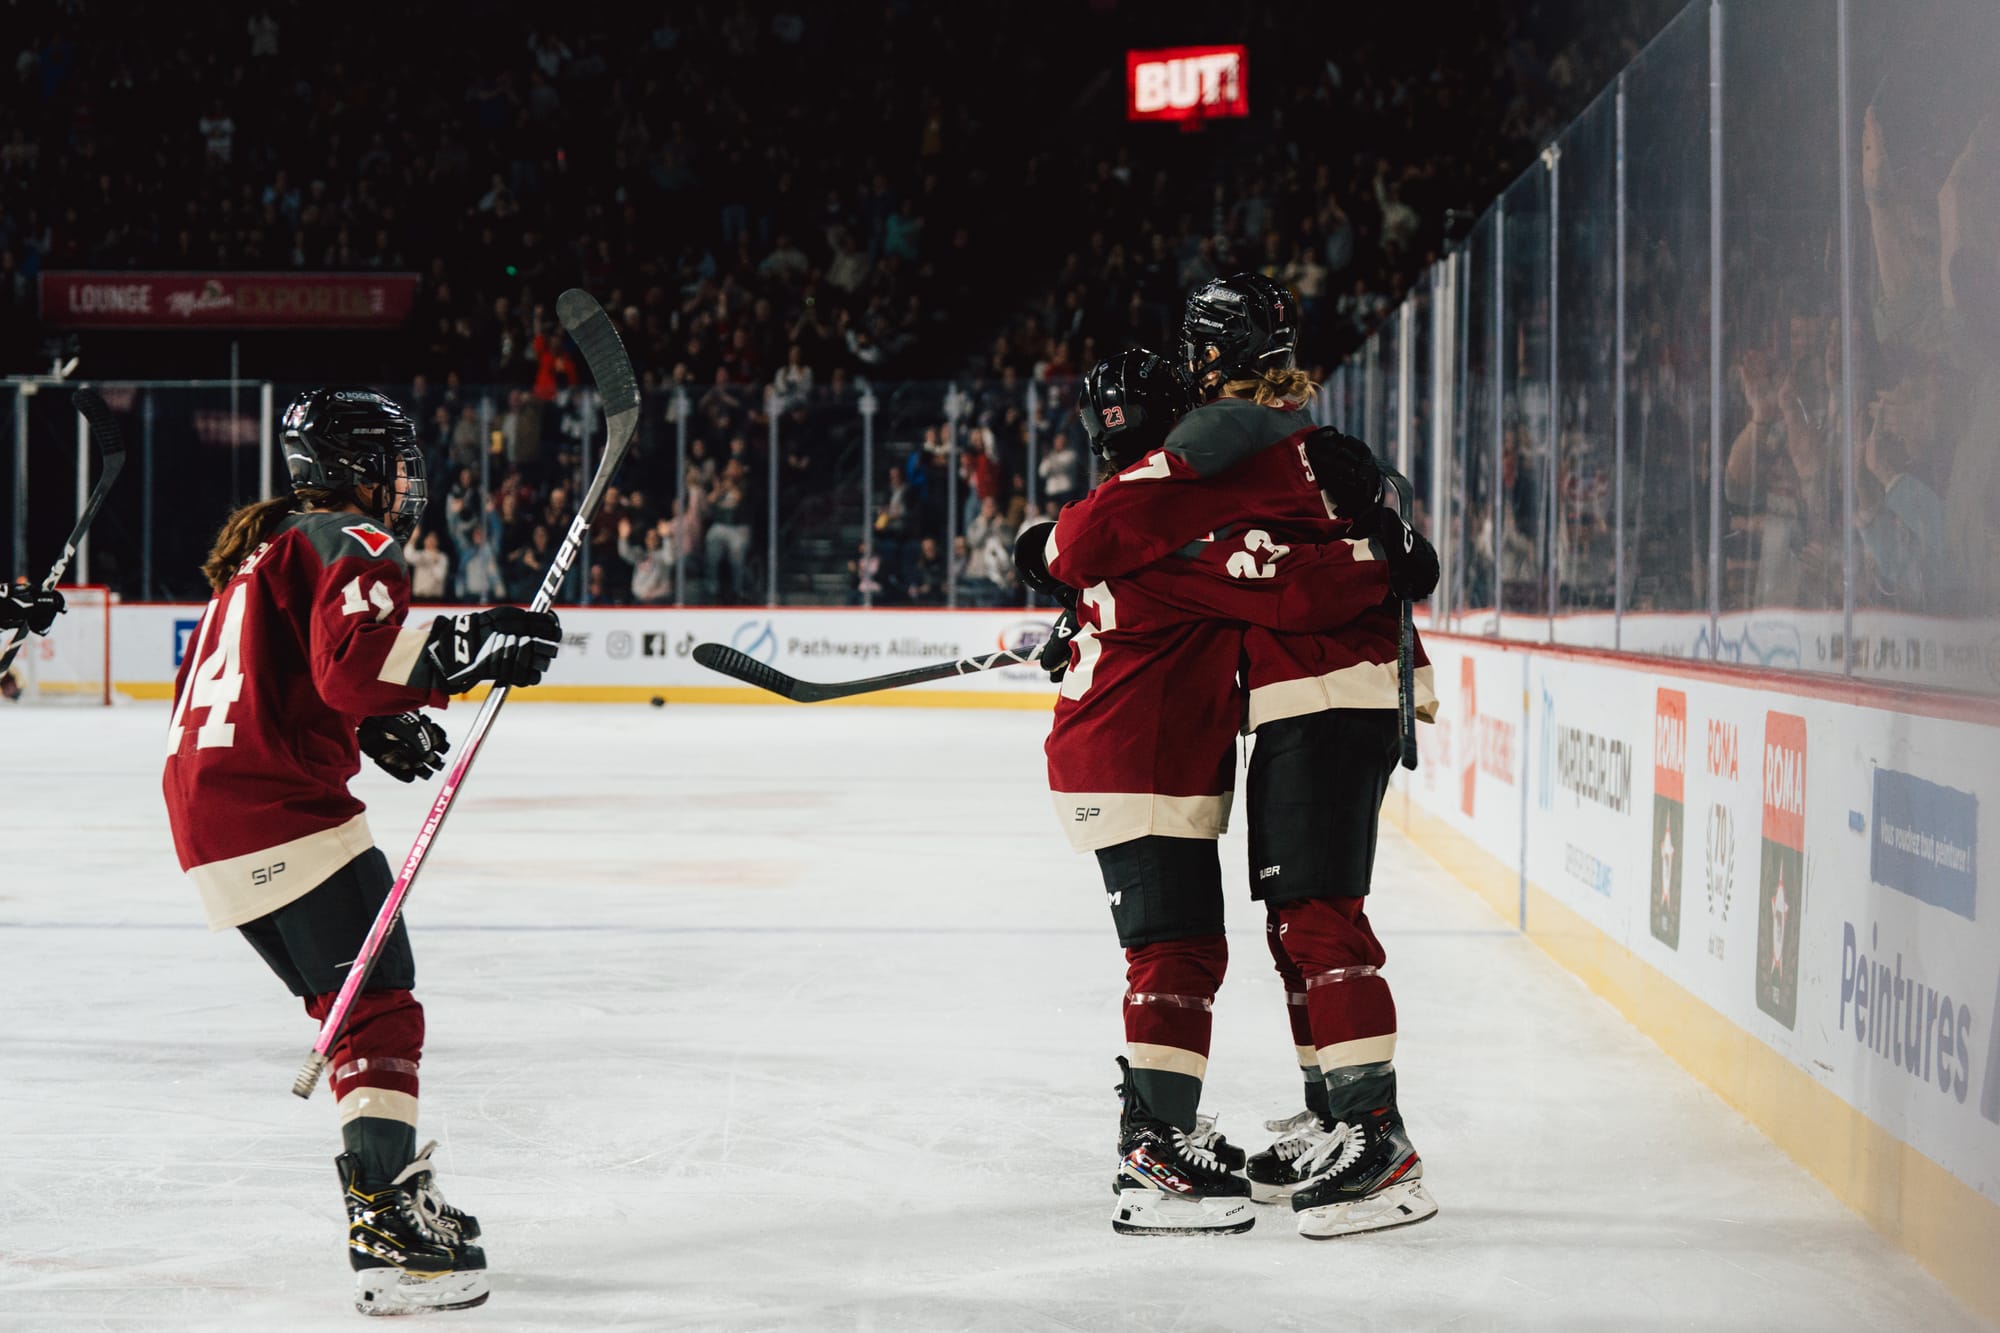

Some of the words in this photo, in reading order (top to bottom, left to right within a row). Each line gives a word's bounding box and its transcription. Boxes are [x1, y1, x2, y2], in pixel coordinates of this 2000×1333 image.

[69, 284, 152, 313] LOUNGE
[1103, 406, 1126, 428] 23
[787, 637, 881, 660] Pathways
[887, 637, 959, 657] Alliance
[1656, 714, 1684, 775] ROMA
[1707, 718, 1739, 782] ROMA
[1765, 743, 1803, 817] ROMA
[1881, 816, 1895, 846] Vous
[1920, 831, 1935, 861] tout
[1840, 921, 1971, 1104] Peintures
[1137, 1151, 1193, 1193] CCM
[1225, 1205, 1245, 1217] CCM
